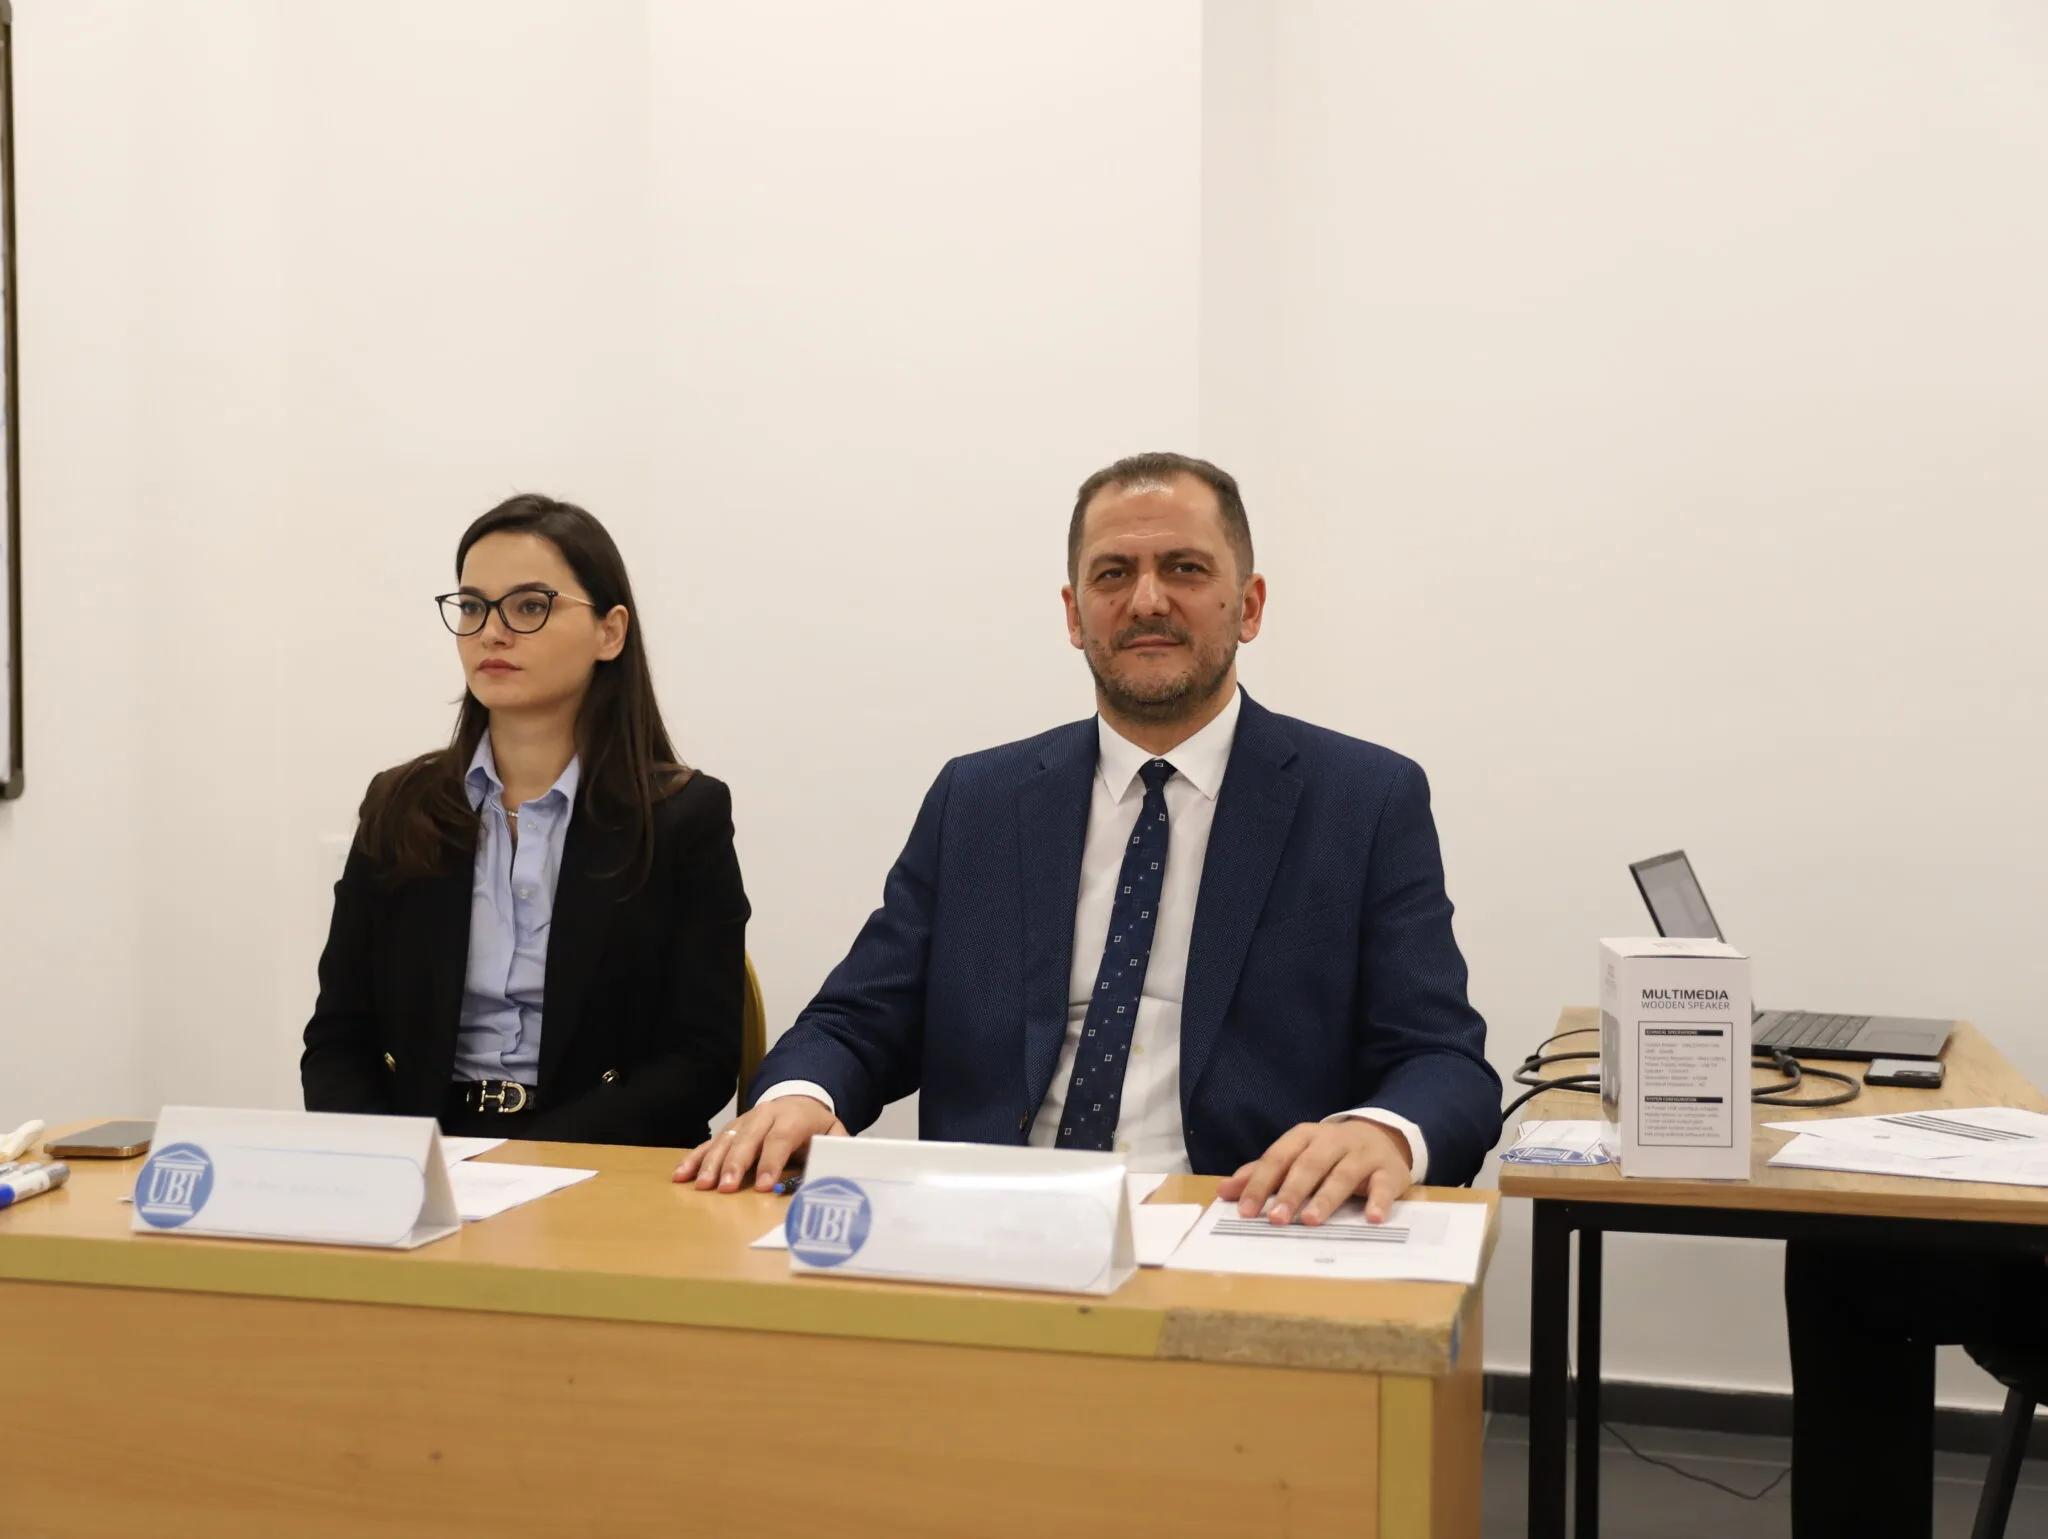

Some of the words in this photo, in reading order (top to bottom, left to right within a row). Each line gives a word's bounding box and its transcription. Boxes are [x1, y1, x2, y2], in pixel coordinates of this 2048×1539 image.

[1641, 1001, 1685, 1009] WOODEN
[1687, 1002, 1730, 1010] SPEAKER
[1642, 989, 1729, 1000] MULTIMEDIA
[149, 1168, 203, 1203] UBT
[801, 1203, 860, 1240] UBT
